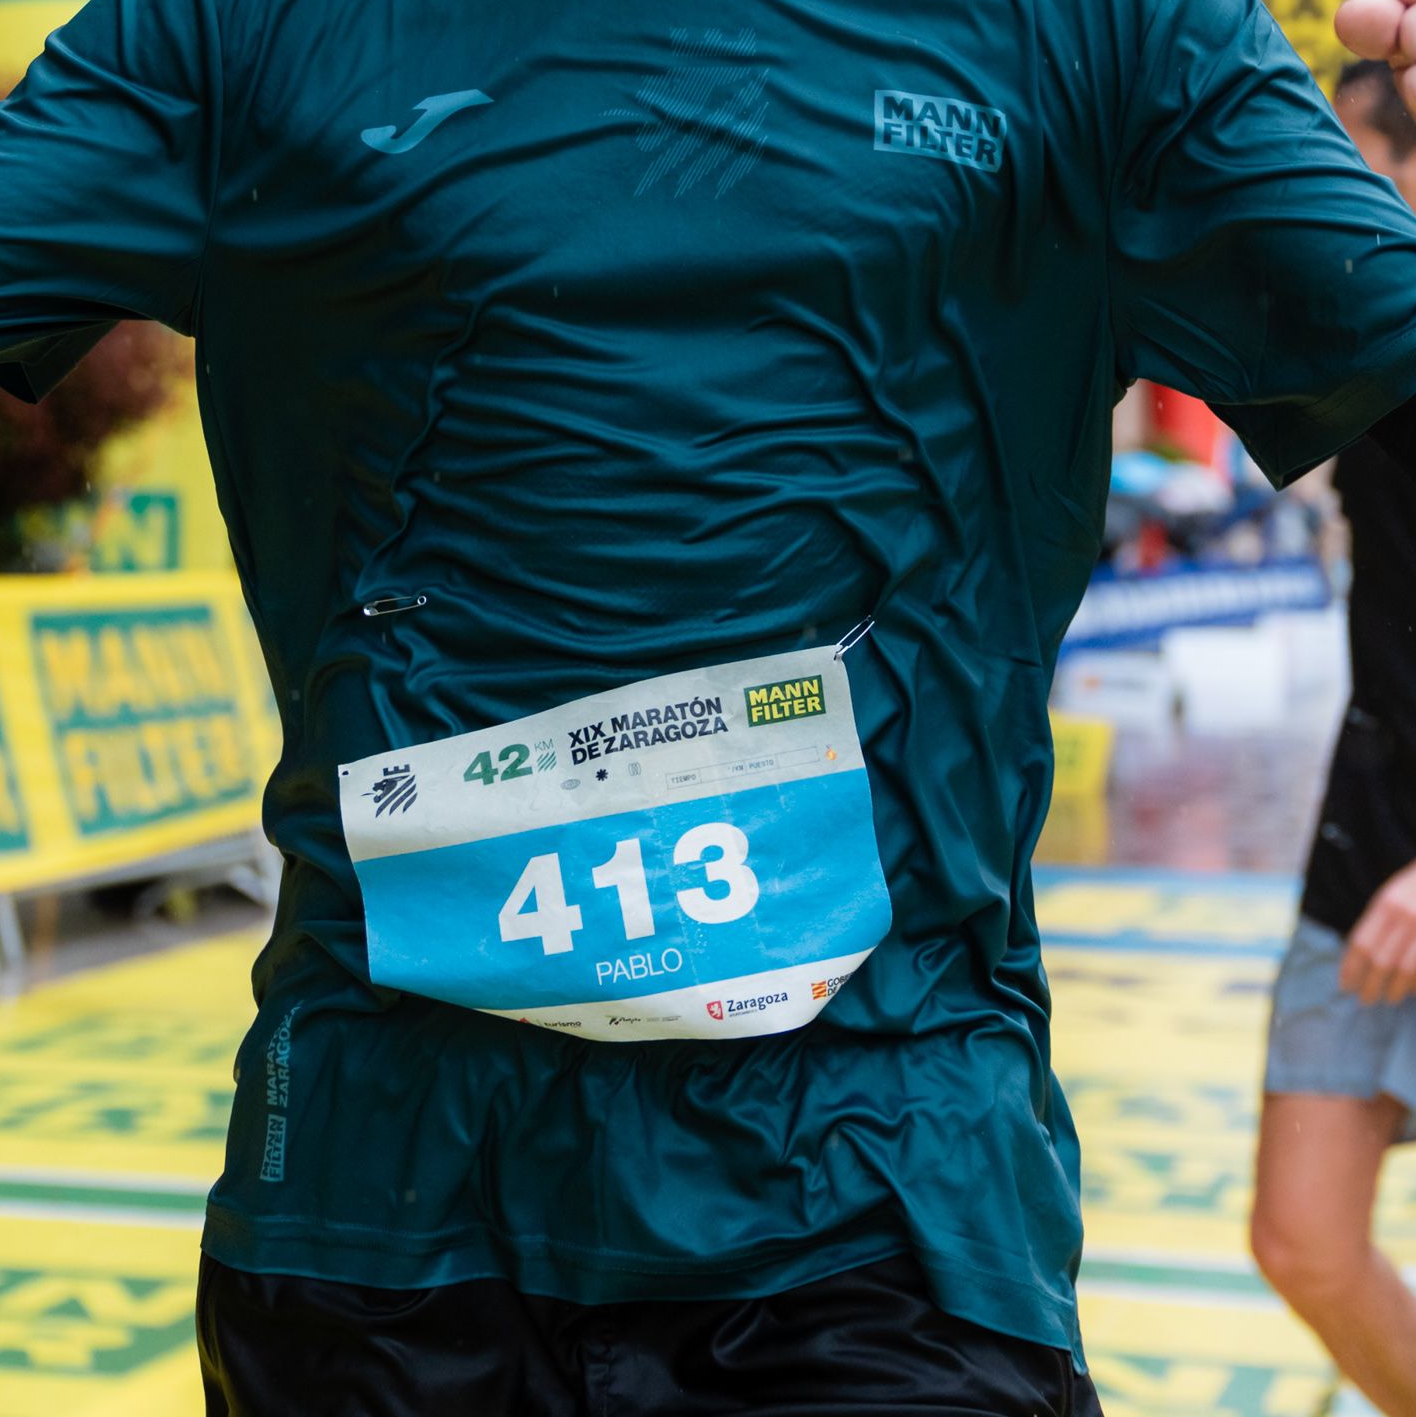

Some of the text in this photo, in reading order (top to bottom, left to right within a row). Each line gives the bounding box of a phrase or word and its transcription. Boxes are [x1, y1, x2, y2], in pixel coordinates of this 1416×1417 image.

[883, 95, 1002, 139] MANN
[883, 121, 997, 166] FILTER
[748, 679, 820, 705] MANN
[751, 696, 824, 724] FILTER
[567, 694, 724, 749] XIX MARATÓN
[569, 716, 729, 767] DE ZARAGOZA
[462, 743, 533, 786] 42
[534, 738, 556, 754] KM
[498, 821, 760, 956] 413
[595, 947, 684, 987] PABLO
[727, 992, 789, 1012] Zaragoza
[275, 1000, 305, 1109] ZARAGOZA
[262, 1118, 278, 1178] MANN
[269, 1120, 284, 1179] FILTER
